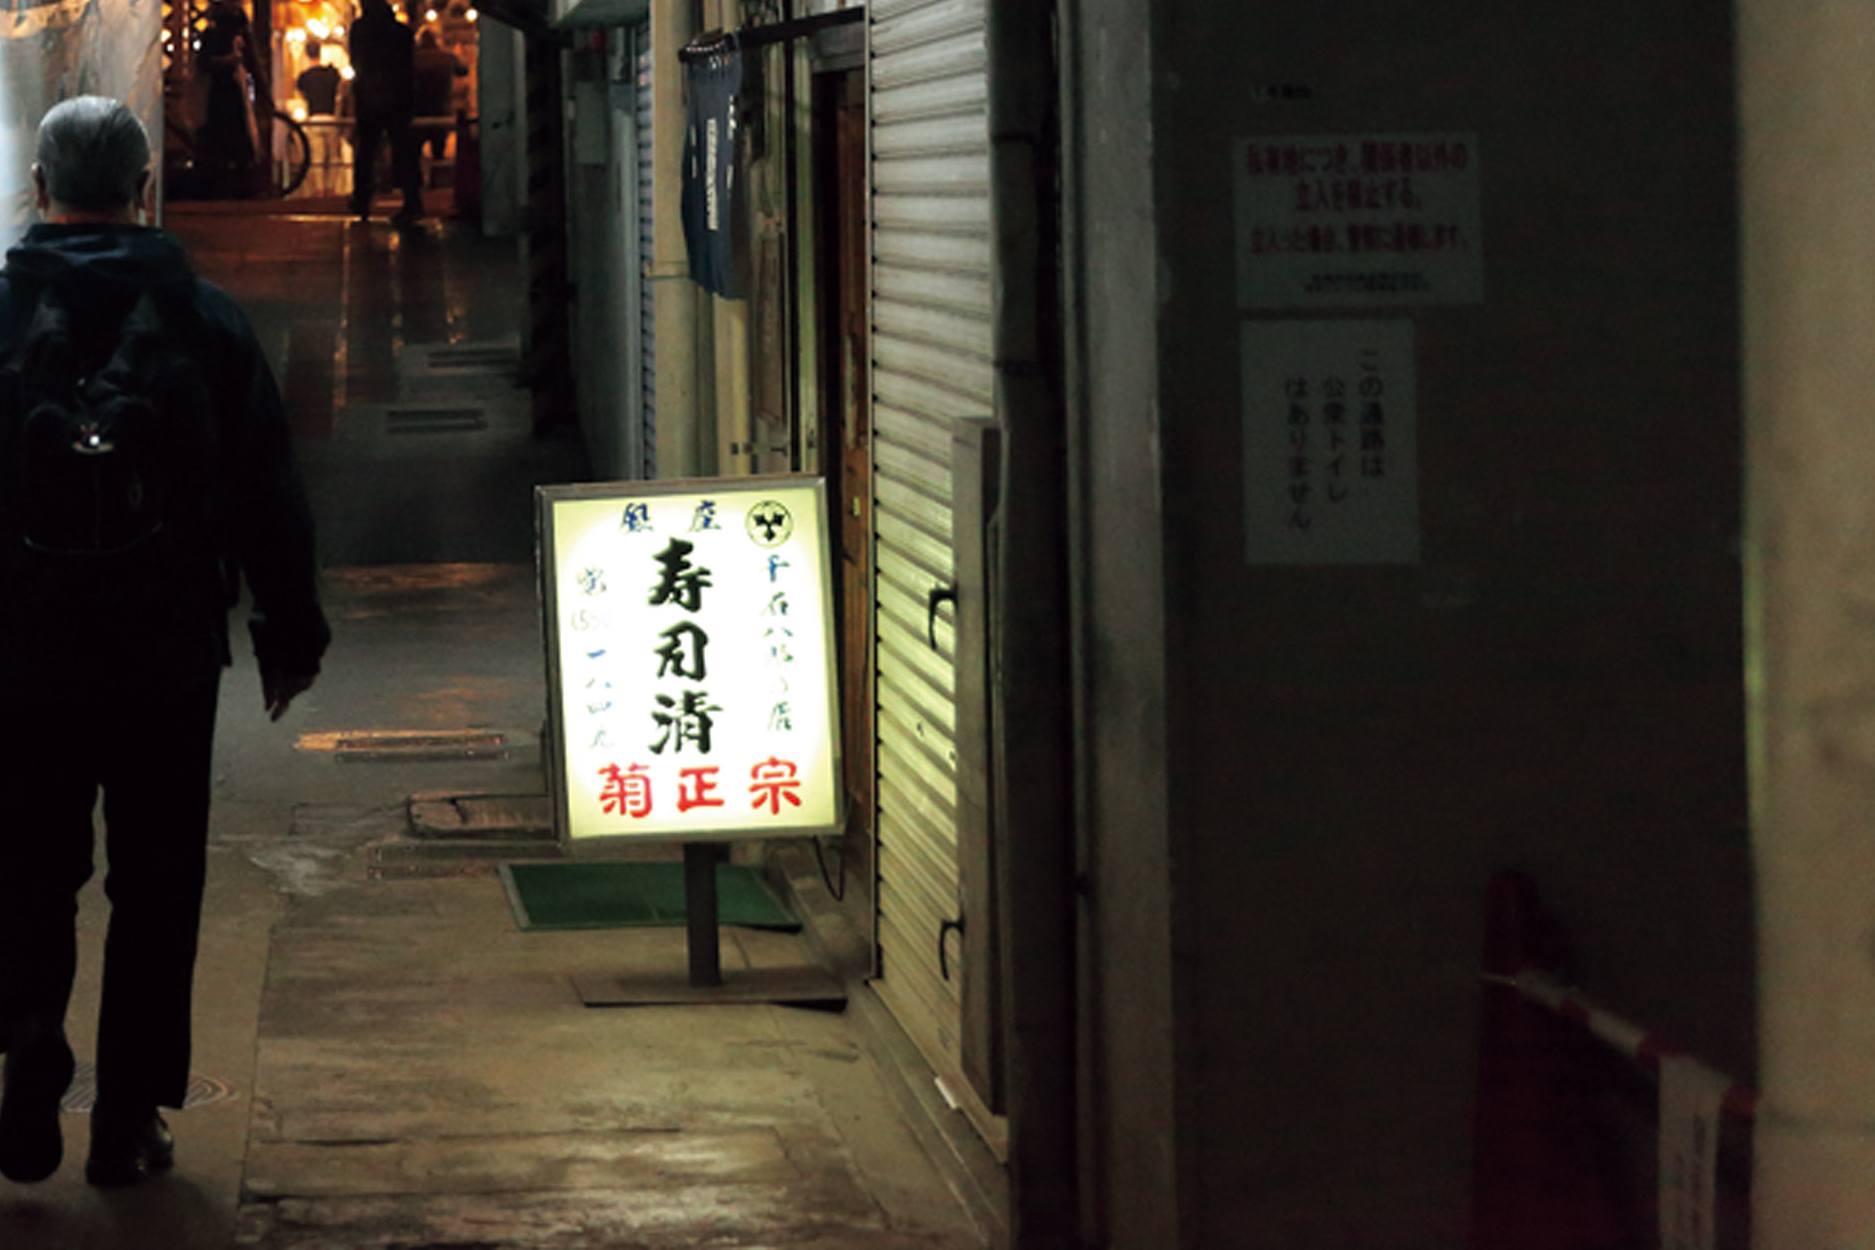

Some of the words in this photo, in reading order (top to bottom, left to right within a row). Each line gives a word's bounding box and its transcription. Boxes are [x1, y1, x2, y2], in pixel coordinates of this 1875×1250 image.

[647, 536, 724, 755] 寿司清
[597, 756, 803, 819] 菊正宗
